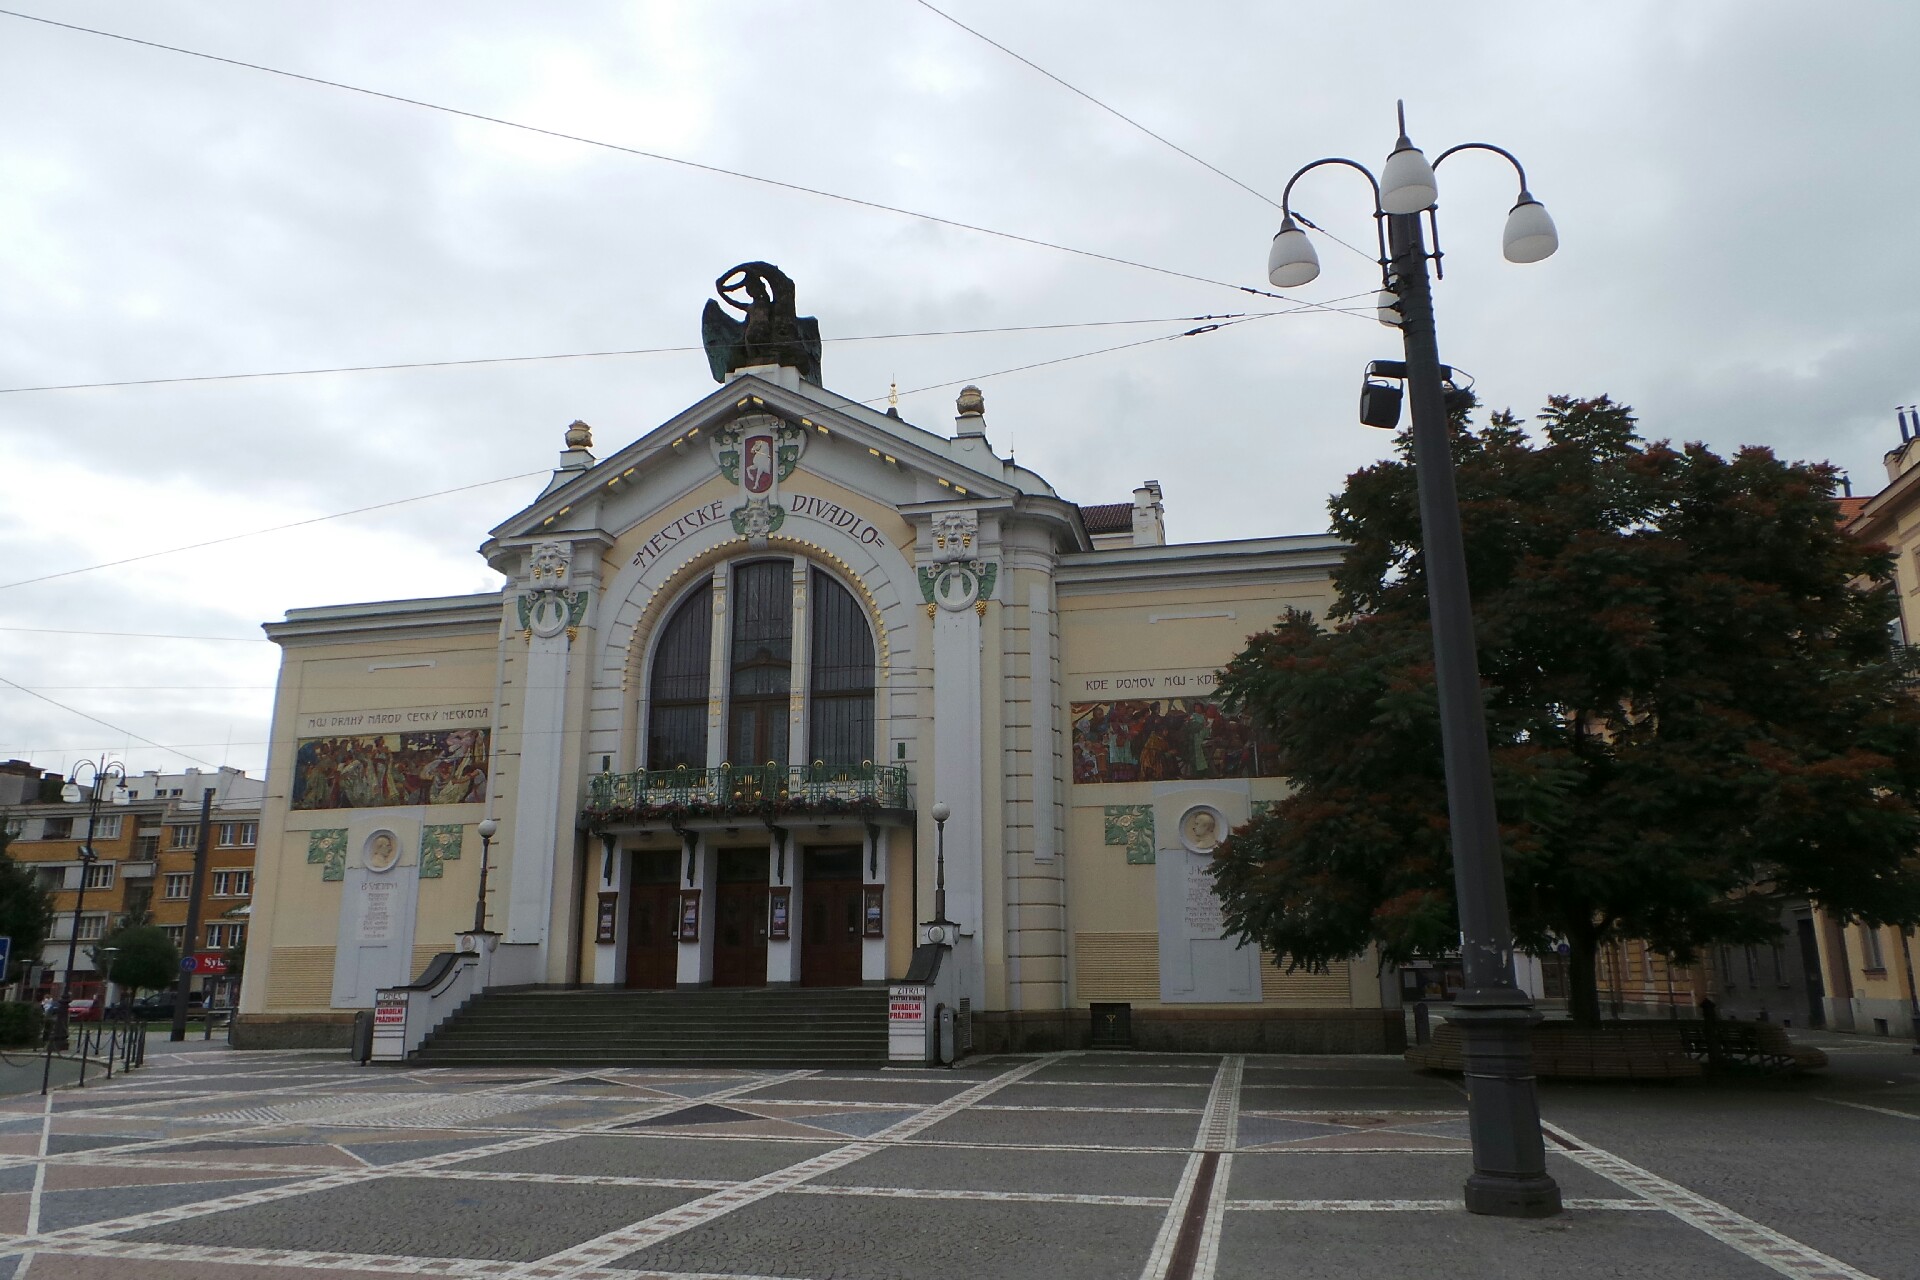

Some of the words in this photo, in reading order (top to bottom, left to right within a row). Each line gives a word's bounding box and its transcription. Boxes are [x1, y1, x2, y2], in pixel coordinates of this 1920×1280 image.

[1086, 680, 1109, 691] KDE
[1116, 678, 1155, 689] DOMOV
[891, 1003, 921, 1011] DIVADELNÍ
